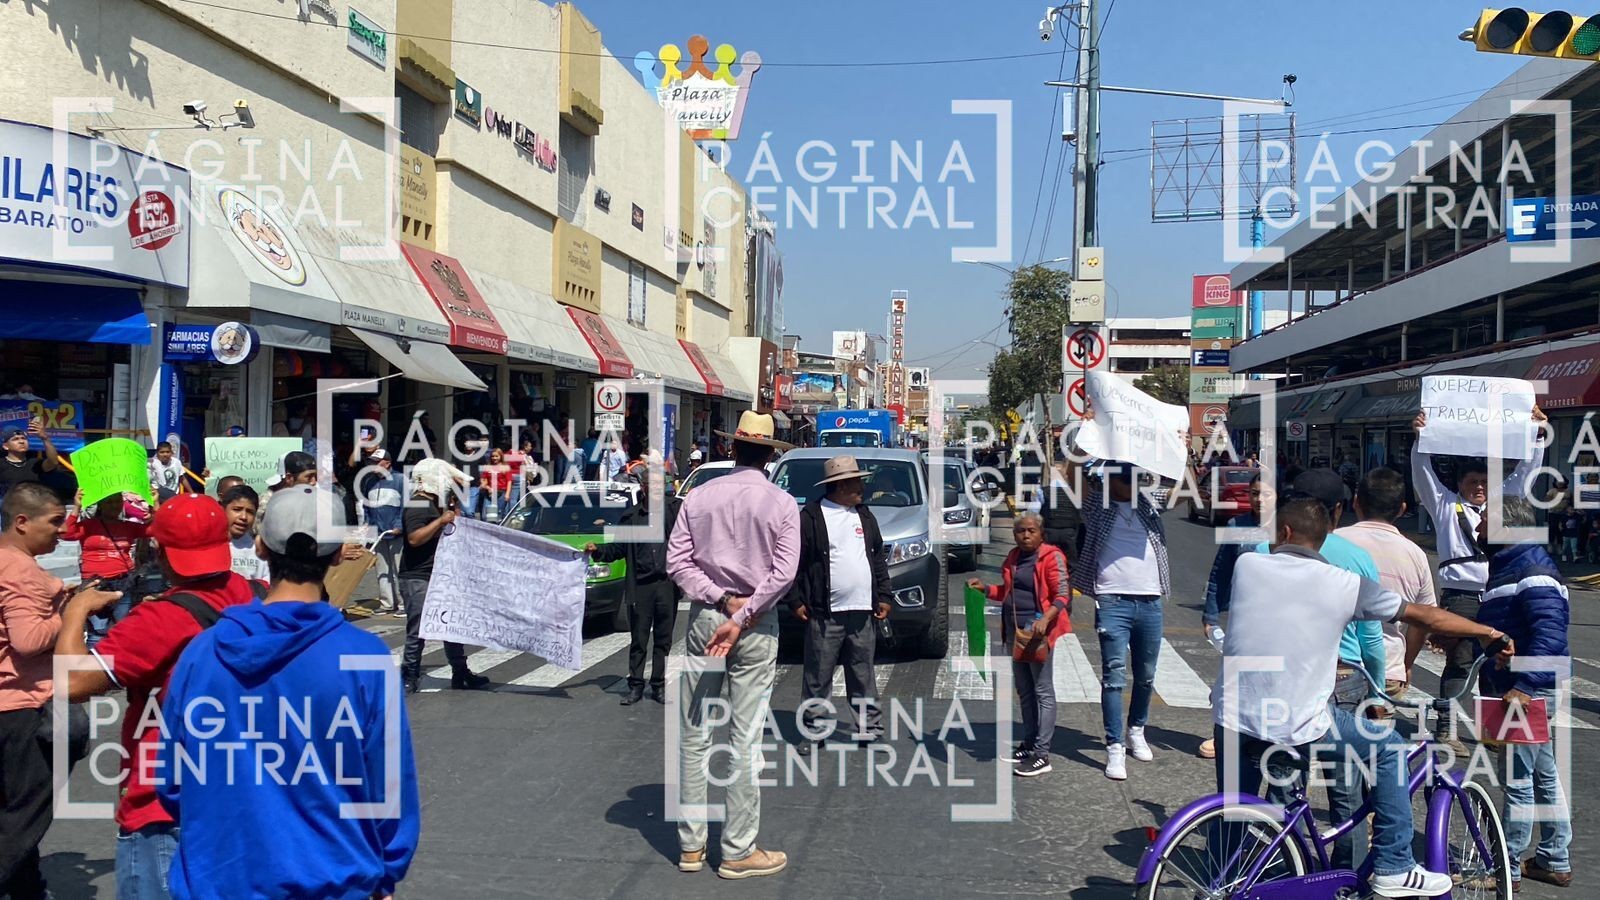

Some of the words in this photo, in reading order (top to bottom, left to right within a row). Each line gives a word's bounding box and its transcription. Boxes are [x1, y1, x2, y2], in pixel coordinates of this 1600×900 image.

[672, 87, 721, 100] Plaza
[1512, 204, 1537, 235] E
[1543, 202, 1599, 213] ENTRADA
[1205, 291, 1230, 299] KING
[361, 314, 386, 327] MANELLY
[167, 332, 210, 342] FARMACIAS
[168, 343, 206, 354] SIMILARES
[1535, 358, 1595, 380] POSTRES
[1424, 377, 1511, 396] QUEREMOS
[1545, 398, 1575, 407] POSTRES
[1422, 402, 1516, 425] TRABAJAR
[209, 442, 268, 463] QUEREMOS
